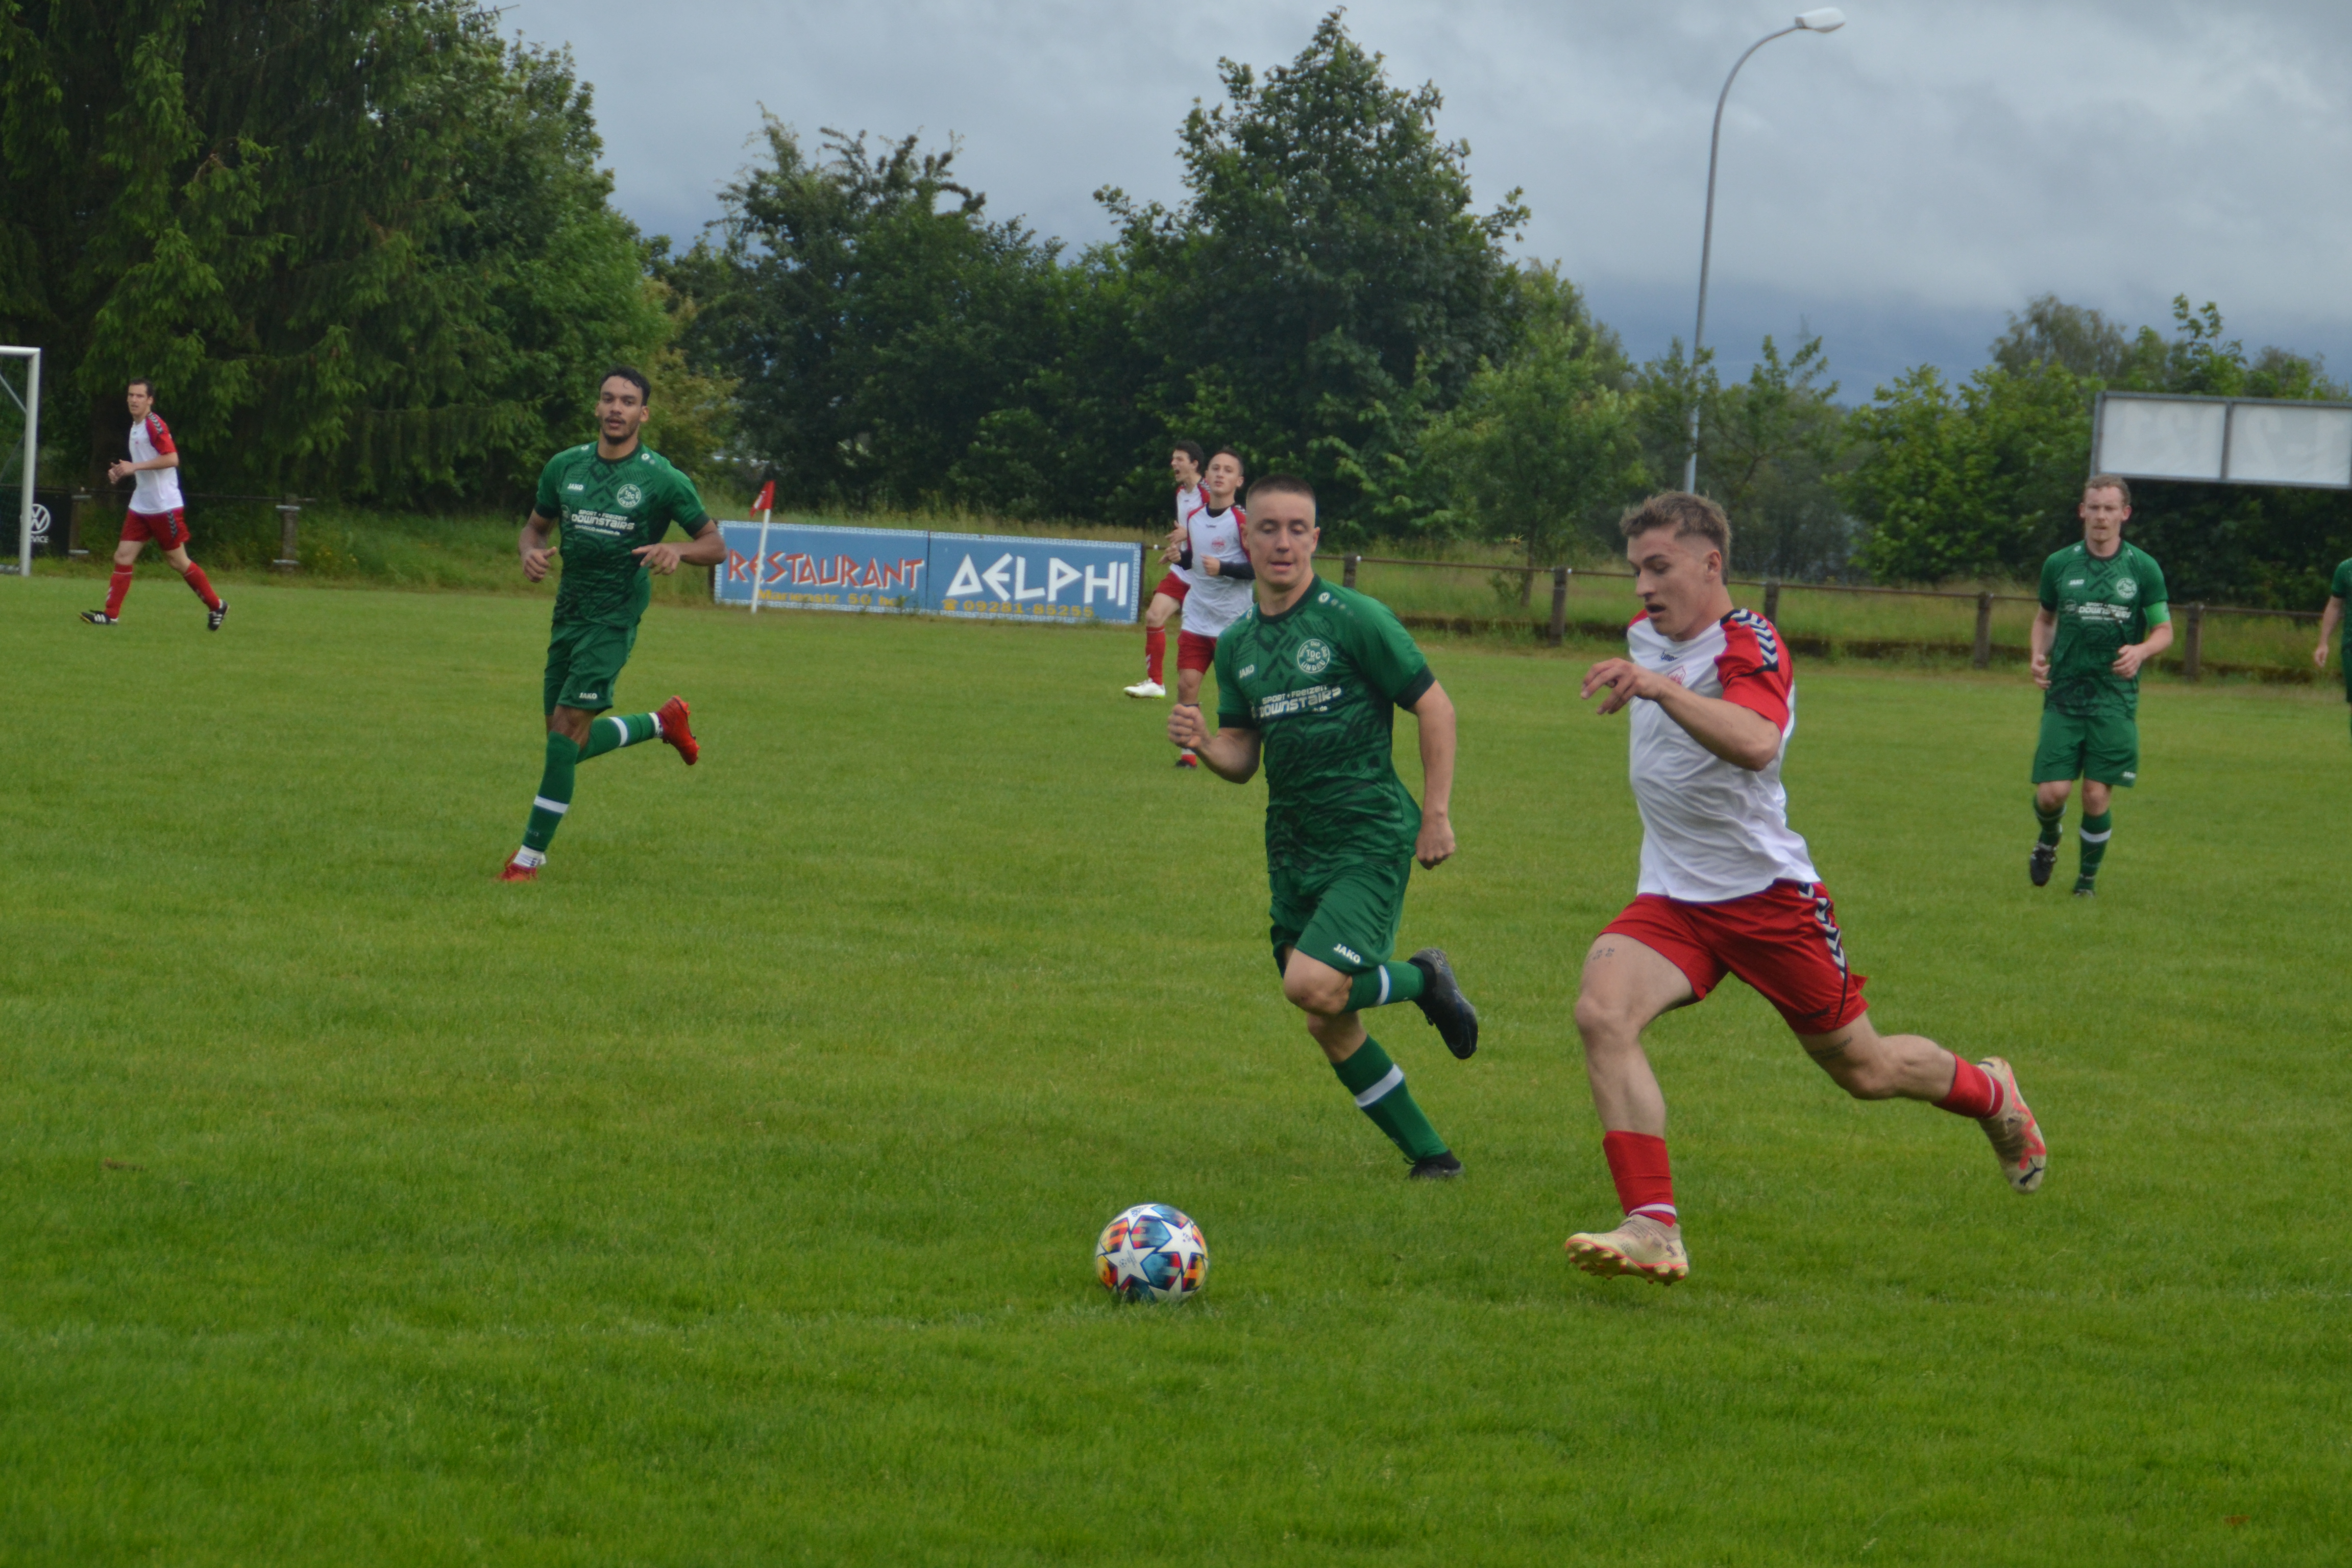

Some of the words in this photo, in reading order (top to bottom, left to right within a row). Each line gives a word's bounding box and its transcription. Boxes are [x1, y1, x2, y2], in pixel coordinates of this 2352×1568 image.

[848, 593, 872, 605] 50
[1306, 649, 1321, 659] TDC
[1239, 664, 1255, 678] JAKO
[1301, 659, 1326, 671] LINDAU
[1262, 693, 1285, 704] SPORT
[1333, 943, 1361, 964] JAKO
